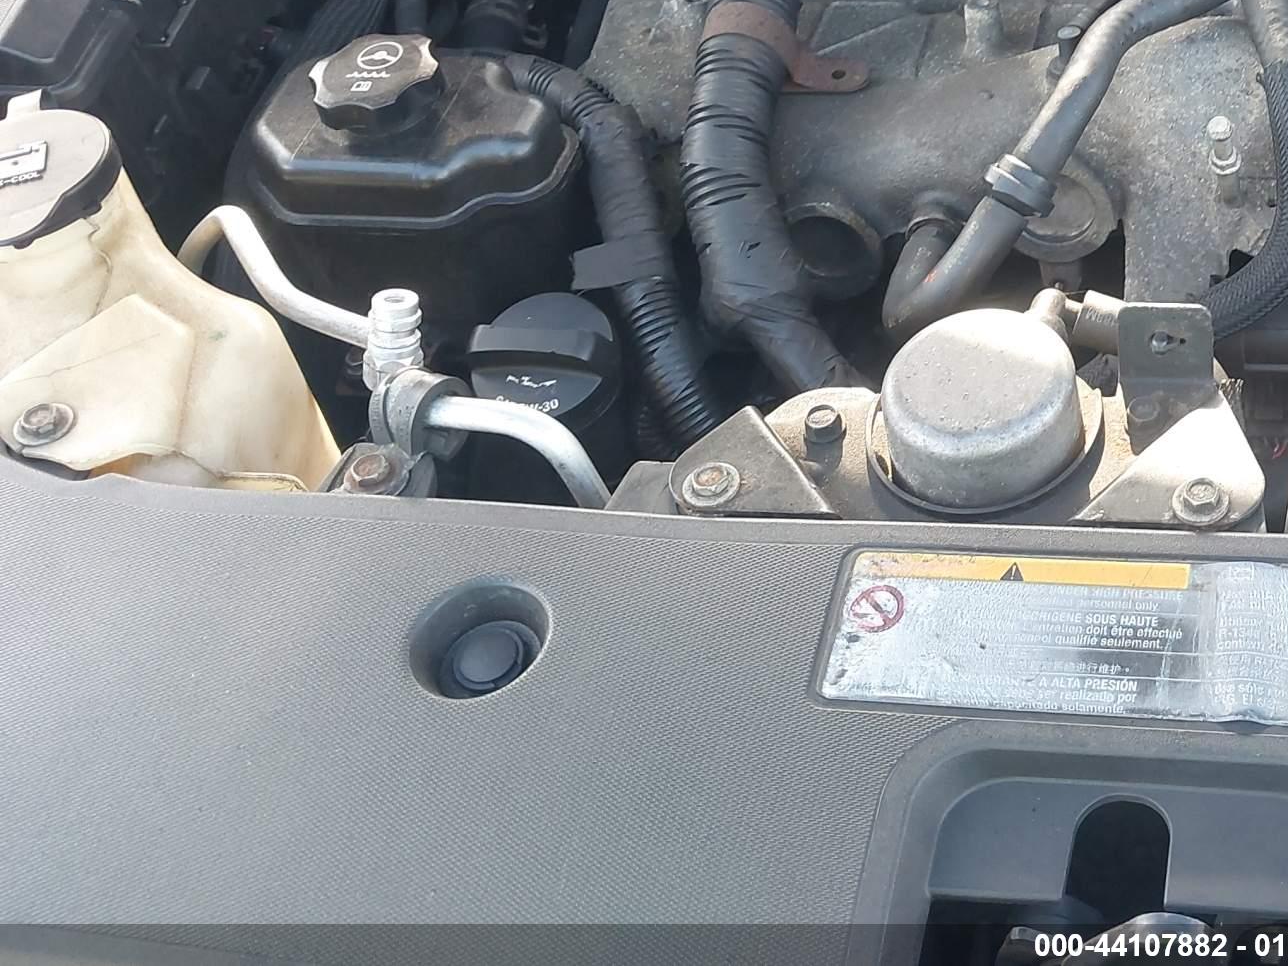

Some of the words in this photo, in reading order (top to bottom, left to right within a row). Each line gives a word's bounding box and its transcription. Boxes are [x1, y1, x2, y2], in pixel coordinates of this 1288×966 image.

[1086, 613, 1117, 625] SOUS
[1120, 615, 1159, 627] HAUTE
[1086, 624, 1108, 635] doit
[1111, 625, 1134, 636] être
[1137, 627, 1183, 639] effectué
[1055, 634, 1098, 646] qualifié
[1039, 676, 1048, 688] A
[1052, 677, 1081, 690] ALTA
[1084, 678, 1138, 692] PRESIÓN
[1059, 690, 1115, 703] realizado
[1117, 693, 1138, 705] por
